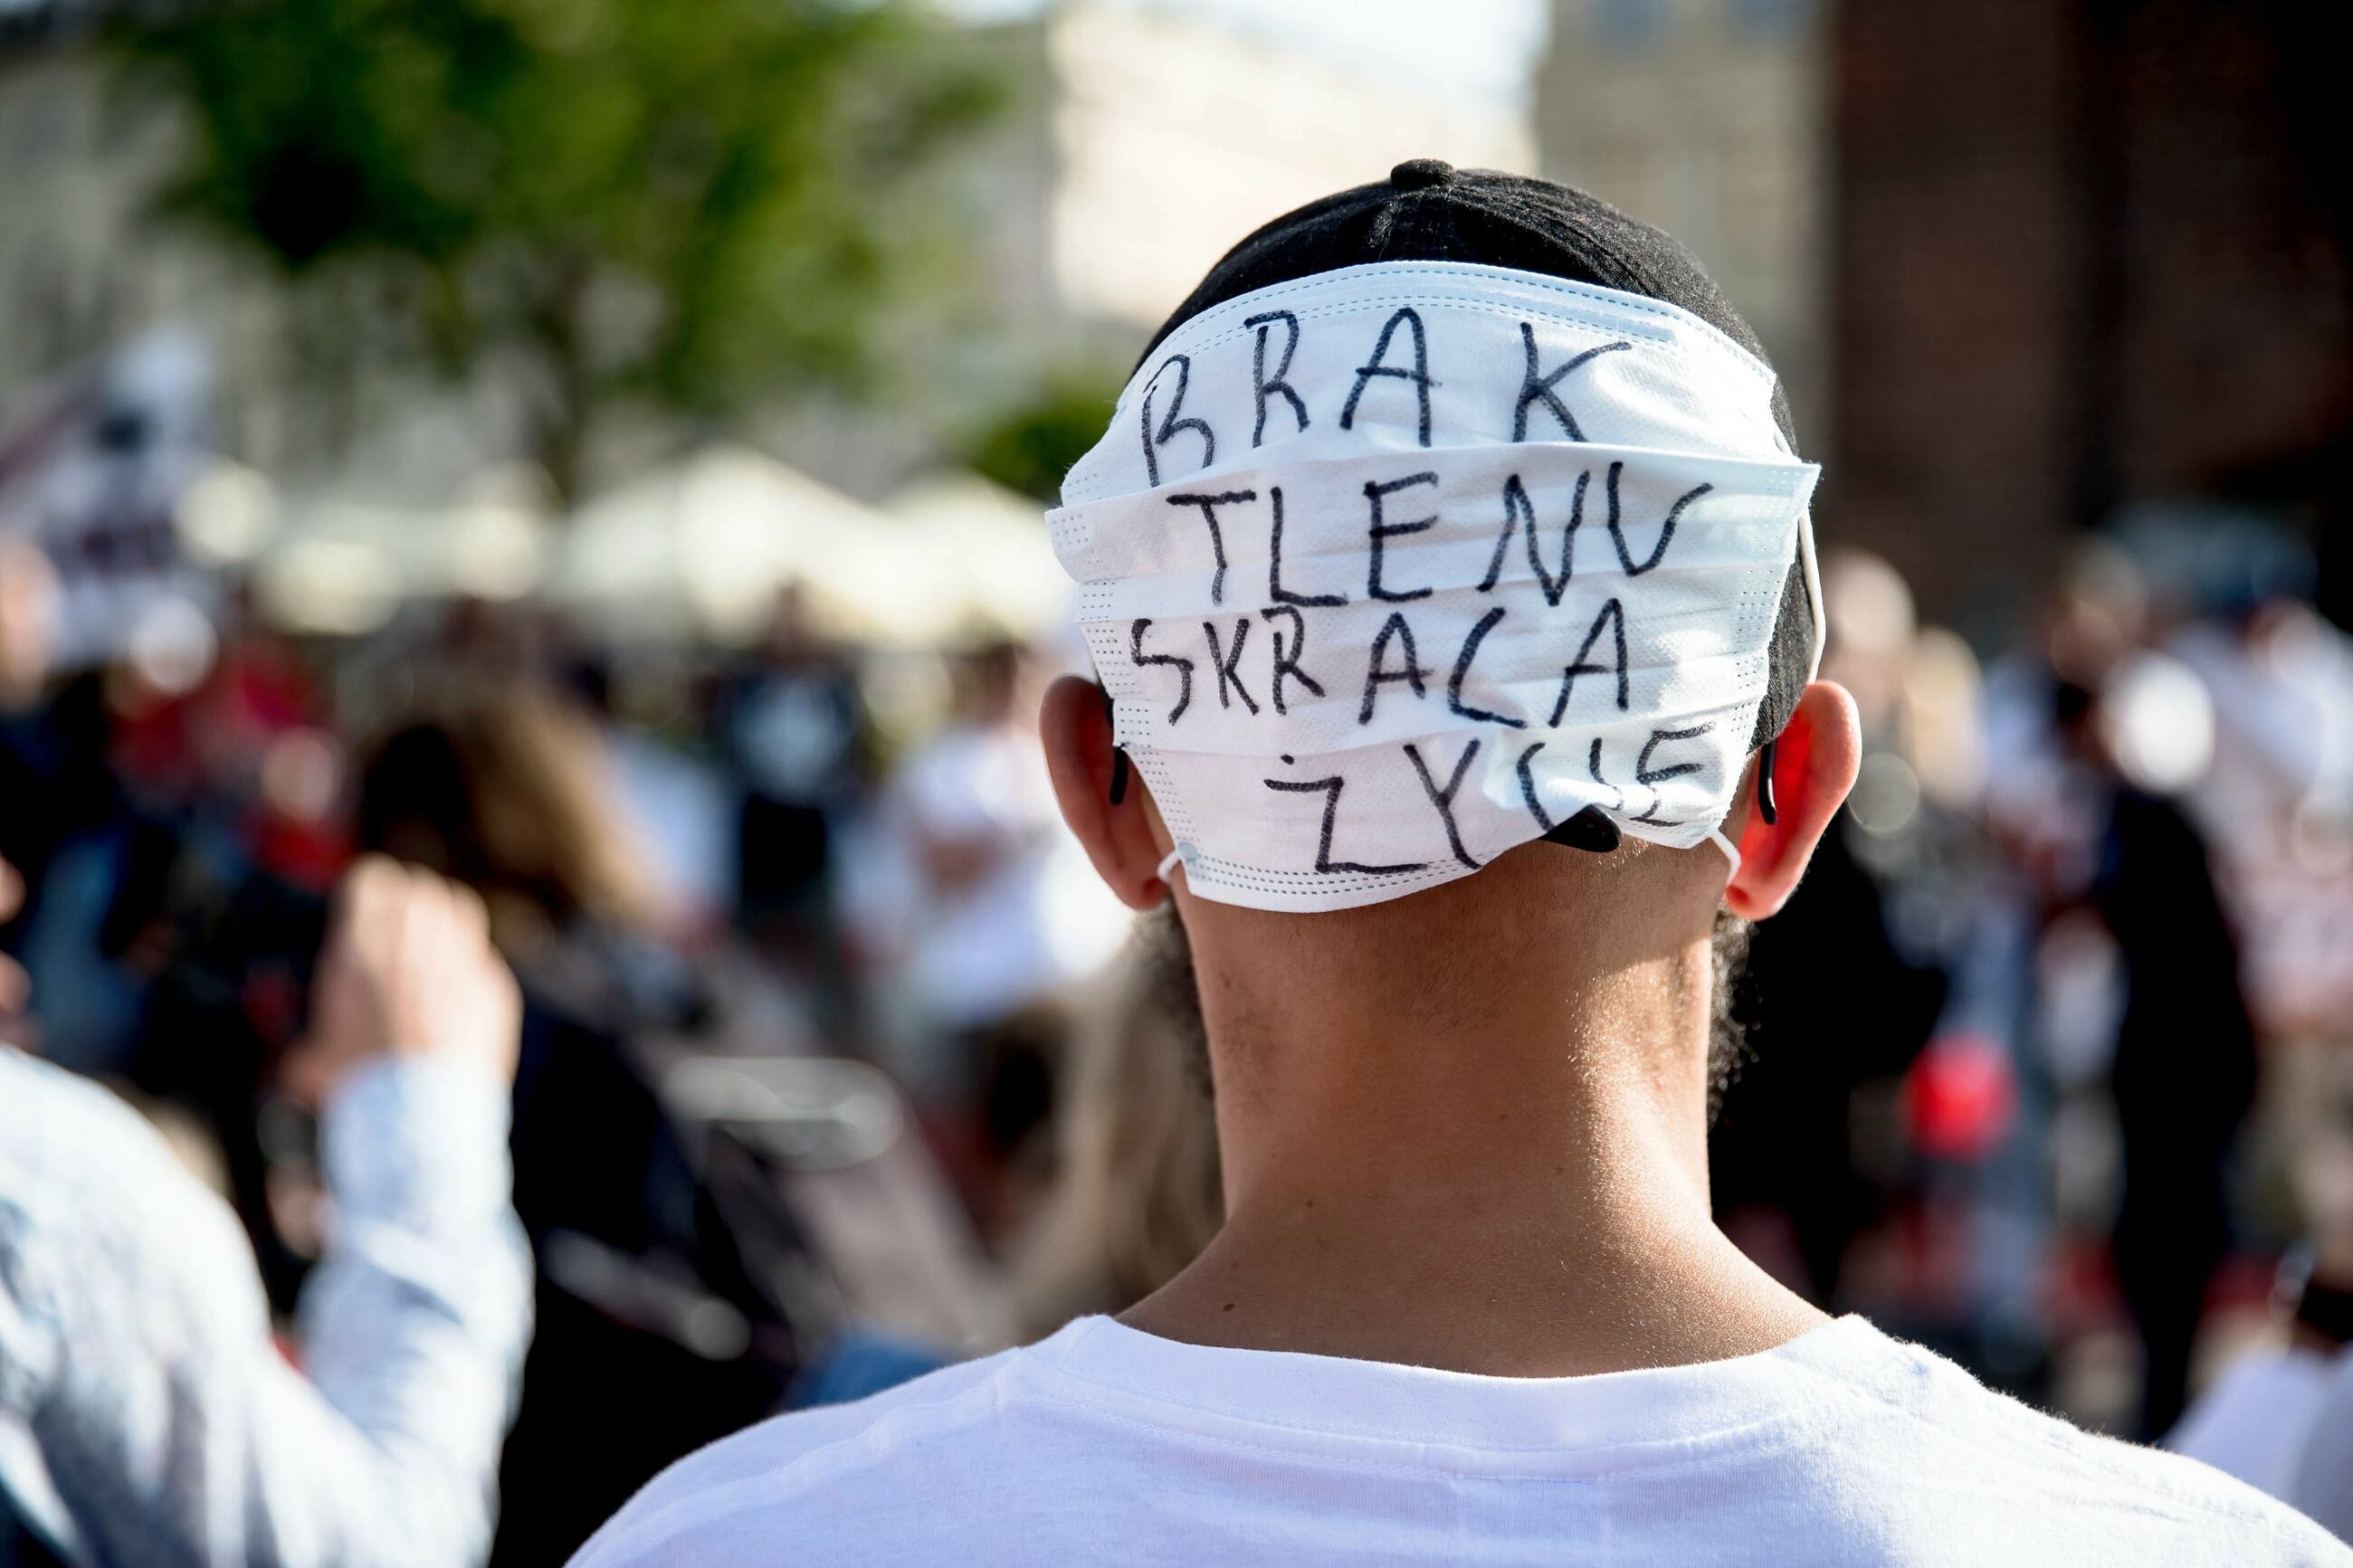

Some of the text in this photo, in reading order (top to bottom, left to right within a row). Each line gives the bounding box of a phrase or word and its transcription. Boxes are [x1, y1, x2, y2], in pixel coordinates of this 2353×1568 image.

[1140, 306, 1633, 488] BRAK
[1167, 461, 1714, 607] TLENU
[1131, 597, 1632, 729] SKRACA
[1264, 721, 1717, 874] ŻYCIE
